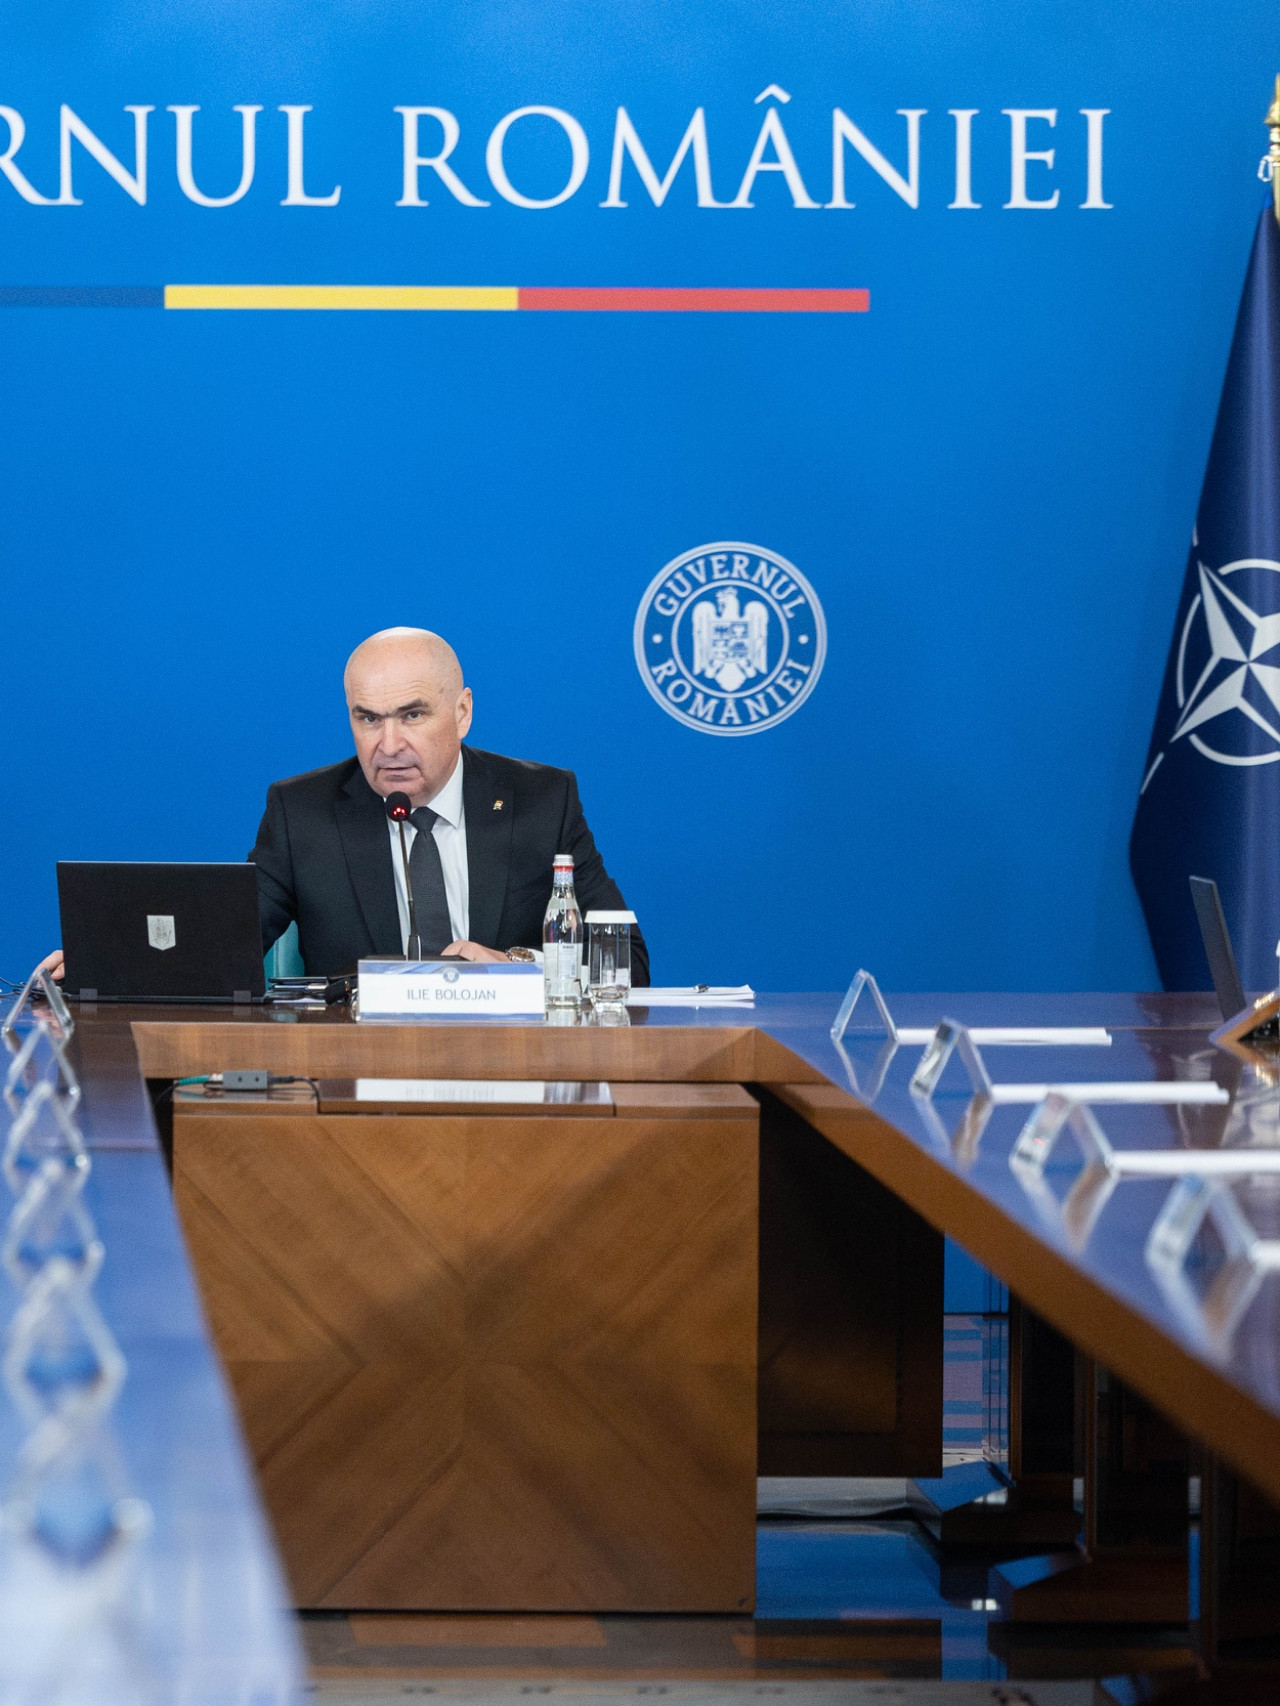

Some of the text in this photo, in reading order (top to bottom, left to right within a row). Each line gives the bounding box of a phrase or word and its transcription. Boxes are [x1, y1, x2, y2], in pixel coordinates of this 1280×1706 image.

[394, 83, 1113, 211] ROMÂNIEI
[653, 553, 807, 619] GUVERNUL
[651, 657, 811, 725] ROMÂNIEI
[407, 988, 497, 1001] ILIE BOLOJAN
